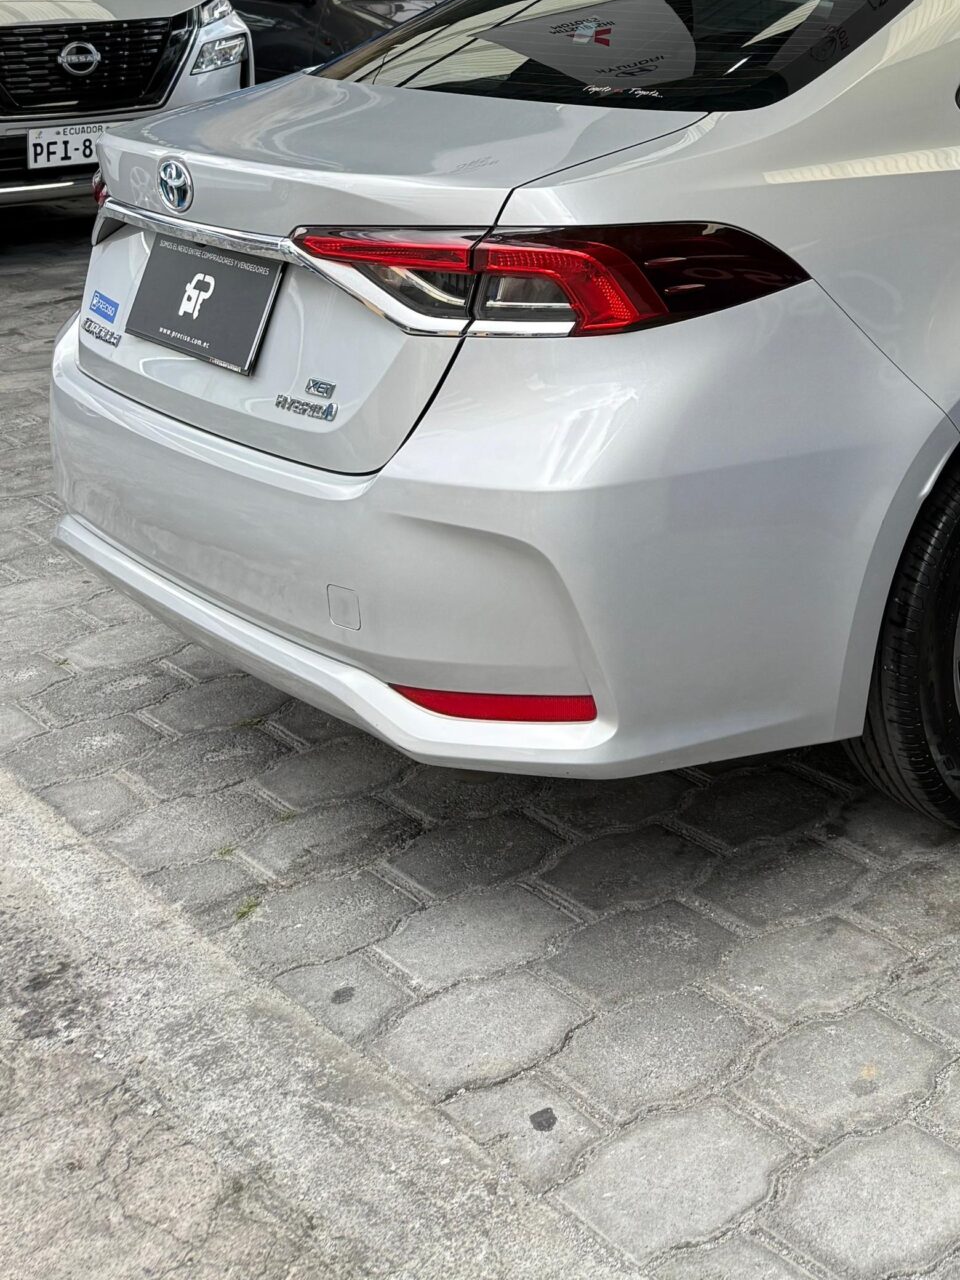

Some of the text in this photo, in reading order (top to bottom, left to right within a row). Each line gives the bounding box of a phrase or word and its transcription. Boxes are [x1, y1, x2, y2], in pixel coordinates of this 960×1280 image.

[58, 51, 101, 64] NISSAN
[62, 125, 104, 137] ECUADOR
[237, 261, 270, 276] VENDEDORES
[159, 326, 210, 349] www.preciso.com.ec
